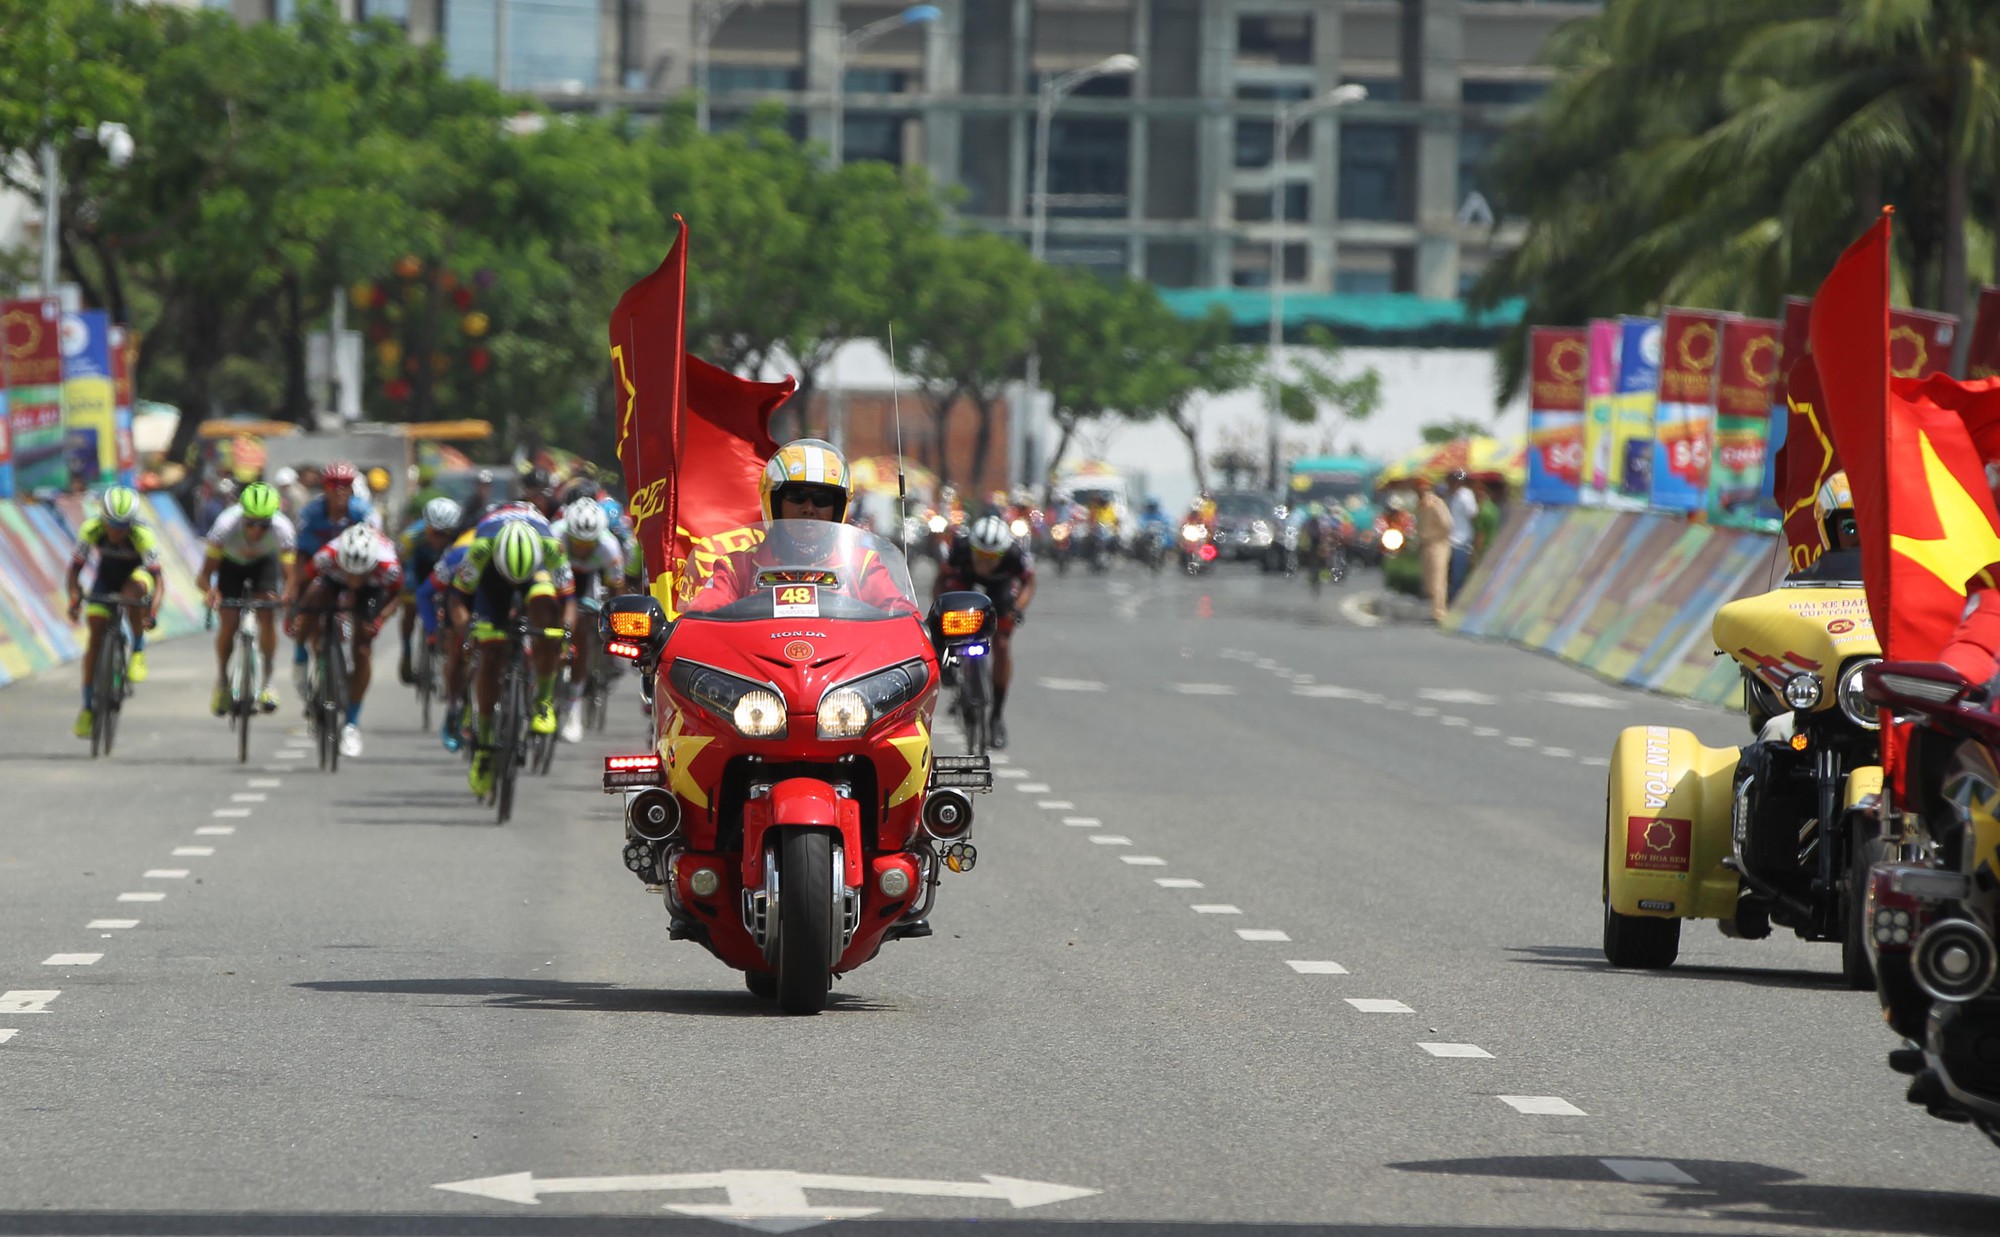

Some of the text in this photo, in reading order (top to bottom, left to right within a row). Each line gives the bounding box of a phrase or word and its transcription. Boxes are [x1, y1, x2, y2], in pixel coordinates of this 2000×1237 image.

[780, 587, 811, 604] 48
[770, 630, 827, 639] HONDA
[1649, 853, 1668, 863] HOA
